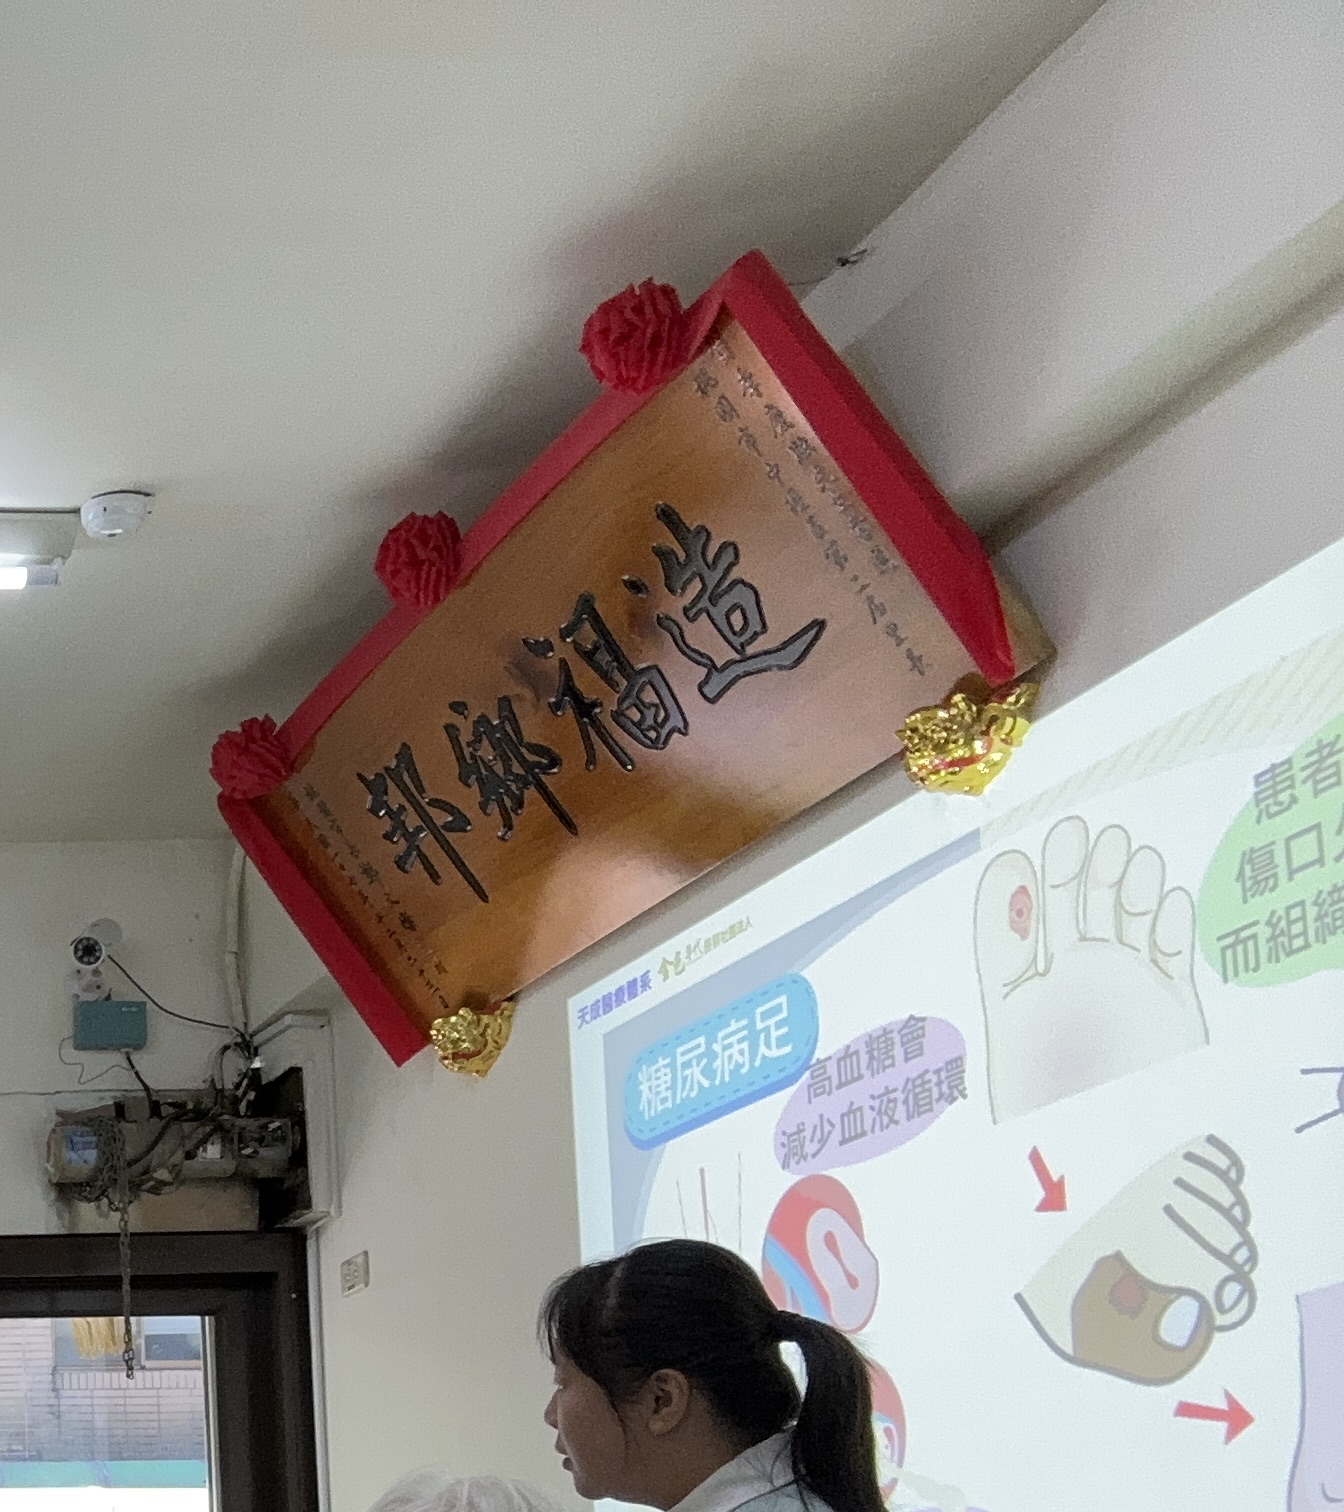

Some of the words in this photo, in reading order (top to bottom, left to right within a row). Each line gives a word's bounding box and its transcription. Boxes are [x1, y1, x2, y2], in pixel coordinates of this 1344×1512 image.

[637, 994, 793, 1121] 糖尿病足
[780, 1054, 969, 1171] 減少血液循環
[805, 1013, 928, 1105] 高血糖會
